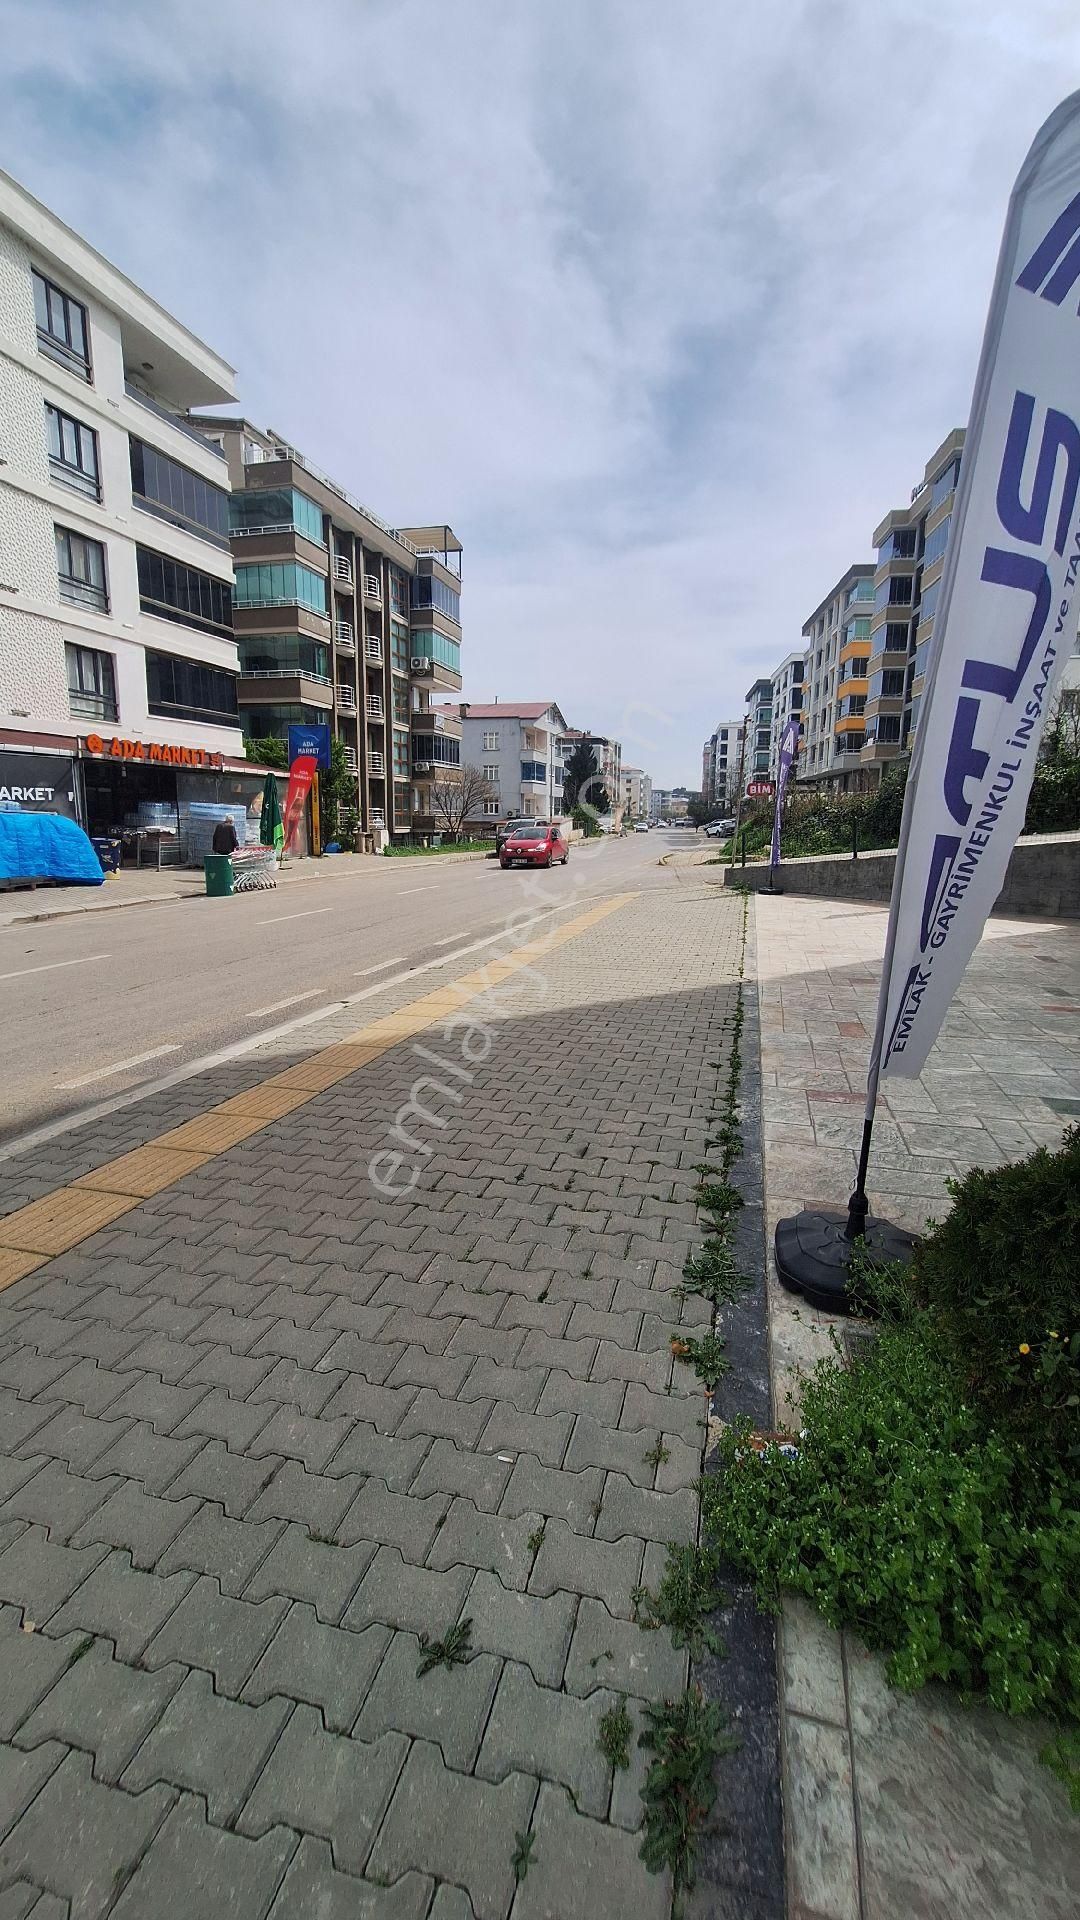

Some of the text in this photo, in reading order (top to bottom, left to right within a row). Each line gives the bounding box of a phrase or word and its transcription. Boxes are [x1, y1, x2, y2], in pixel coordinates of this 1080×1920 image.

[109, 737, 206, 766] ADA MARKET
[0, 786, 55, 801] ARKET
[750, 783, 771, 794] BİM
[893, 971, 932, 1053] EMLAK
[930, 757, 1022, 949] GAYRİMENKUL
[1005, 640, 1057, 750] İNŞAAT
[1055, 599, 1069, 632] ve
